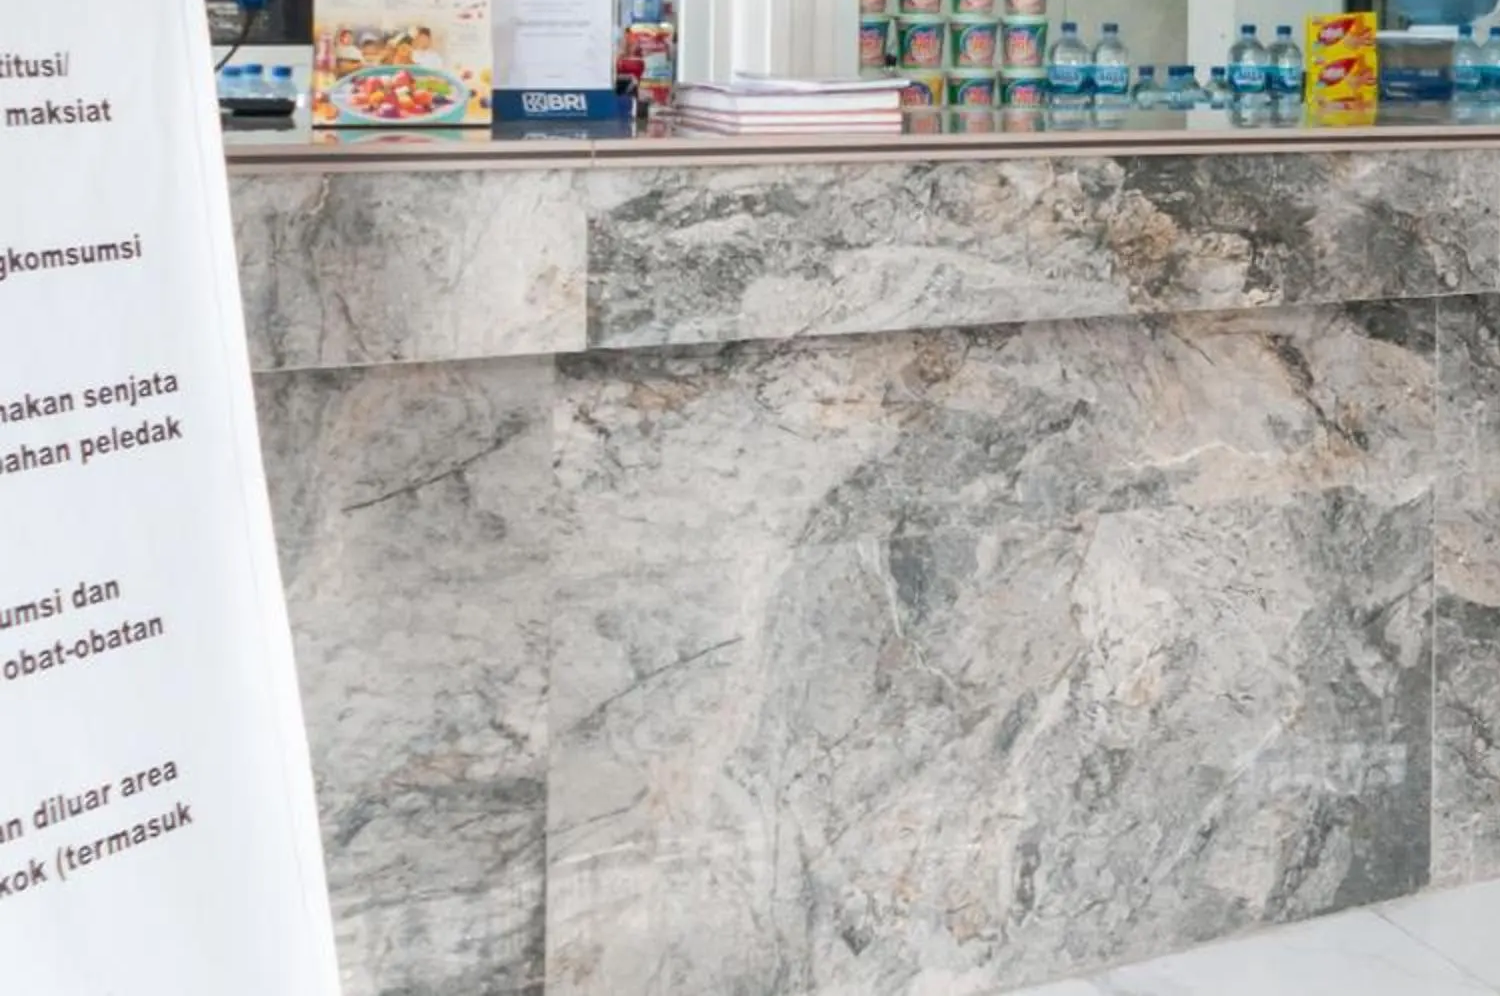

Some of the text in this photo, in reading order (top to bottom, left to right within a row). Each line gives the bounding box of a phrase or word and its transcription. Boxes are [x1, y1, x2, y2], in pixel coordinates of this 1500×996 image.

[5, 98, 112, 126] maksiat
[547, 92, 588, 111] BRI
[83, 371, 179, 407] senjata
[0, 415, 183, 475] ahan peledak
[71, 579, 121, 609] dan
[2, 616, 164, 681] obat-obatan
[32, 782, 113, 831] diluar
[120, 759, 179, 798] area
[55, 801, 194, 882] (termasuk
